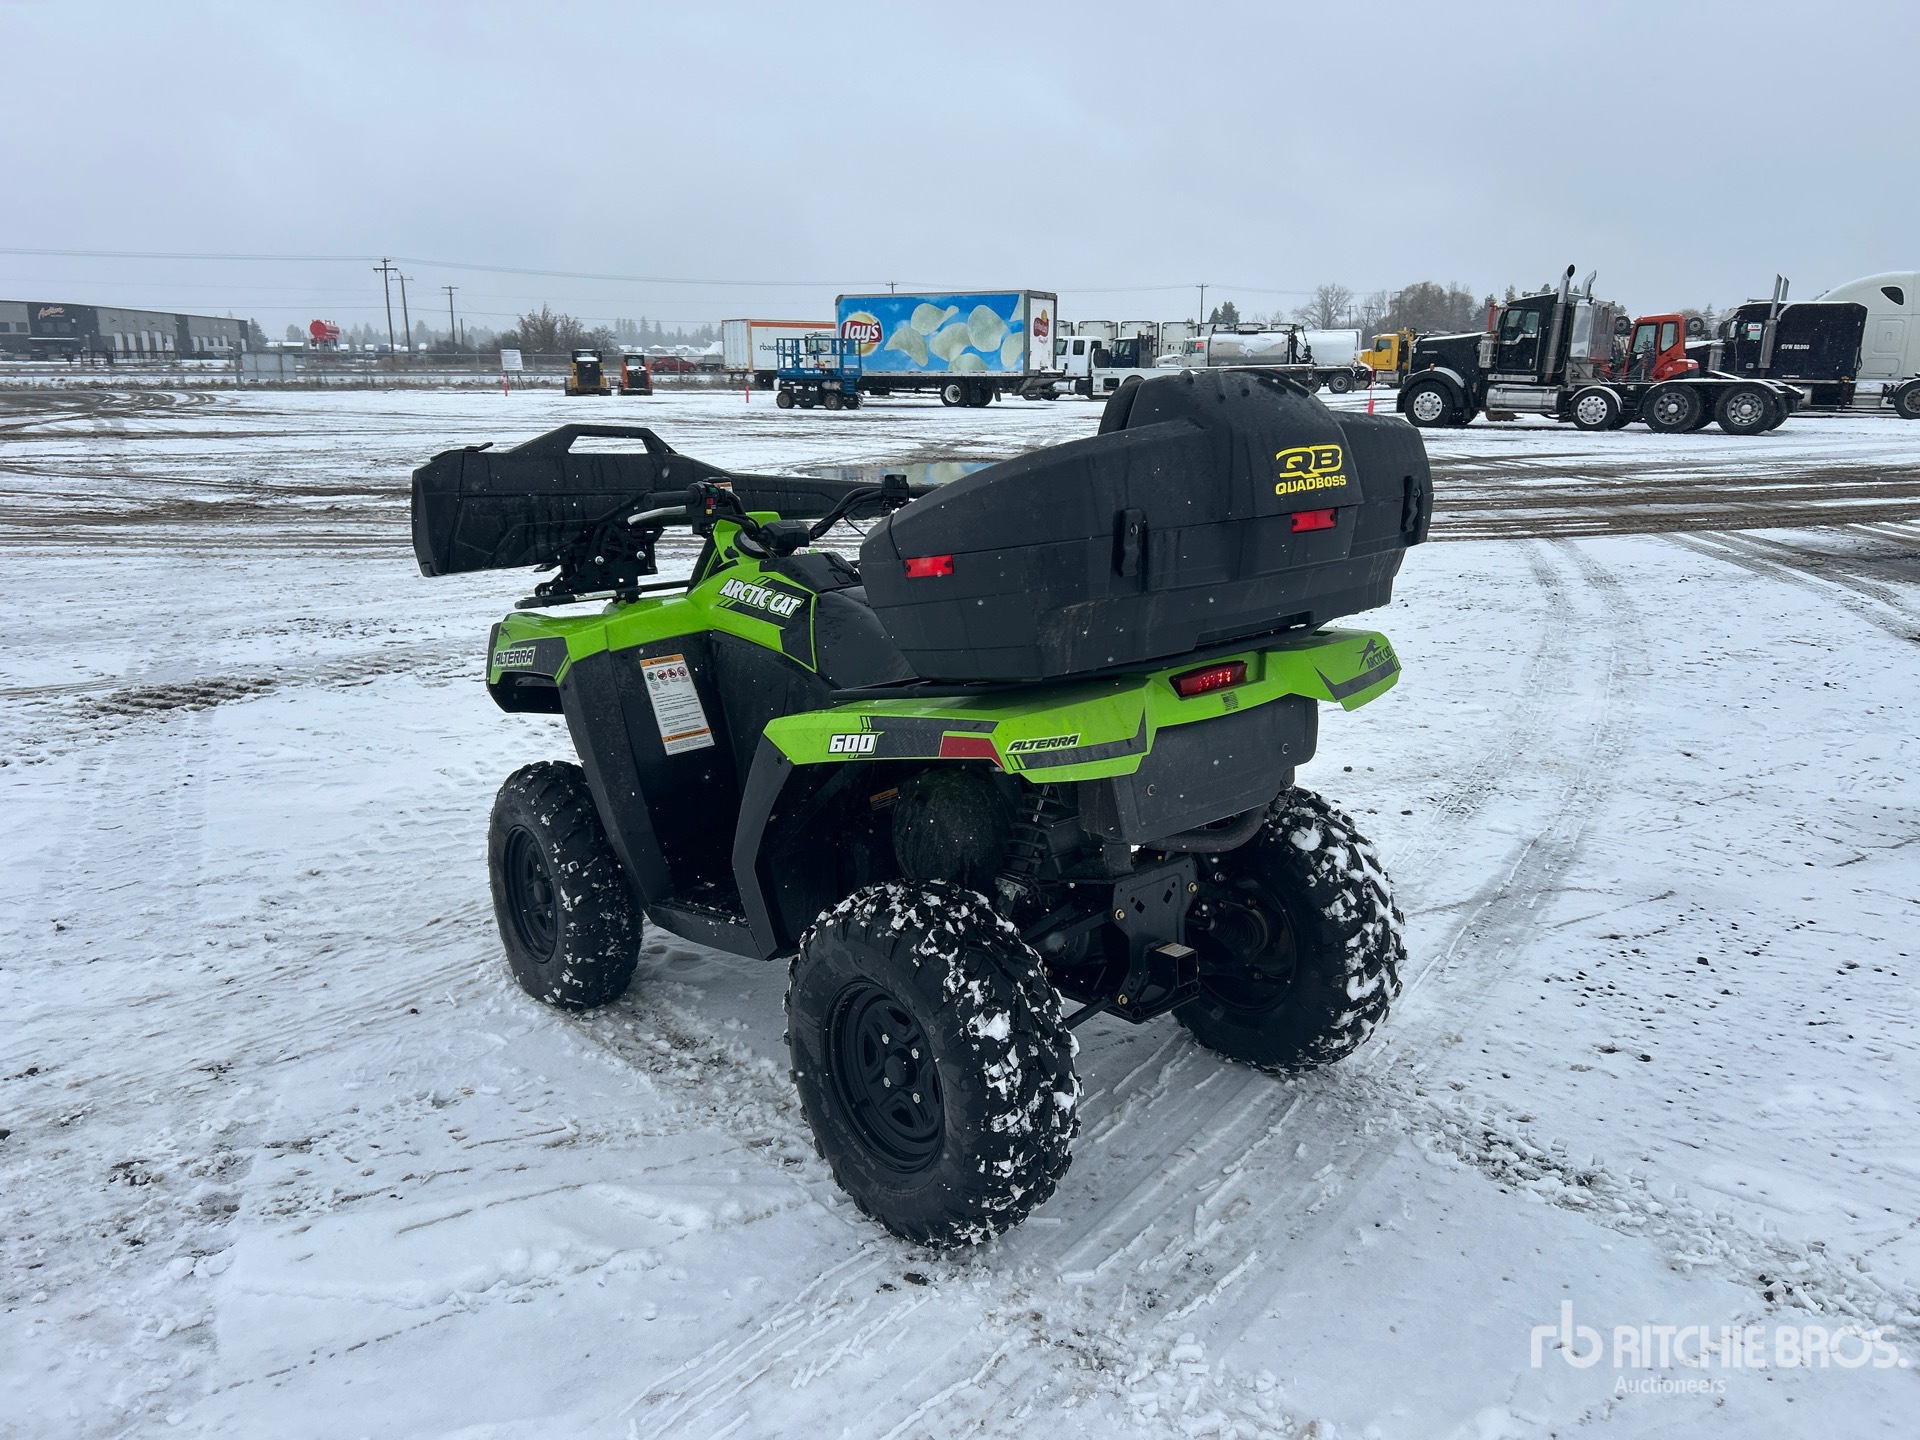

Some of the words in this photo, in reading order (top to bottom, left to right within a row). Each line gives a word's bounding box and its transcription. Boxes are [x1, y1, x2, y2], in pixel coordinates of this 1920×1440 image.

[1275, 444, 1342, 478] QB
[1275, 475, 1347, 495] QUADBOSS
[719, 578, 772, 608] ARCTIC
[769, 593, 802, 616] CAT
[494, 648, 535, 666] ALTERRA
[829, 734, 876, 753] 600
[1007, 734, 1080, 752] ALTERRA
